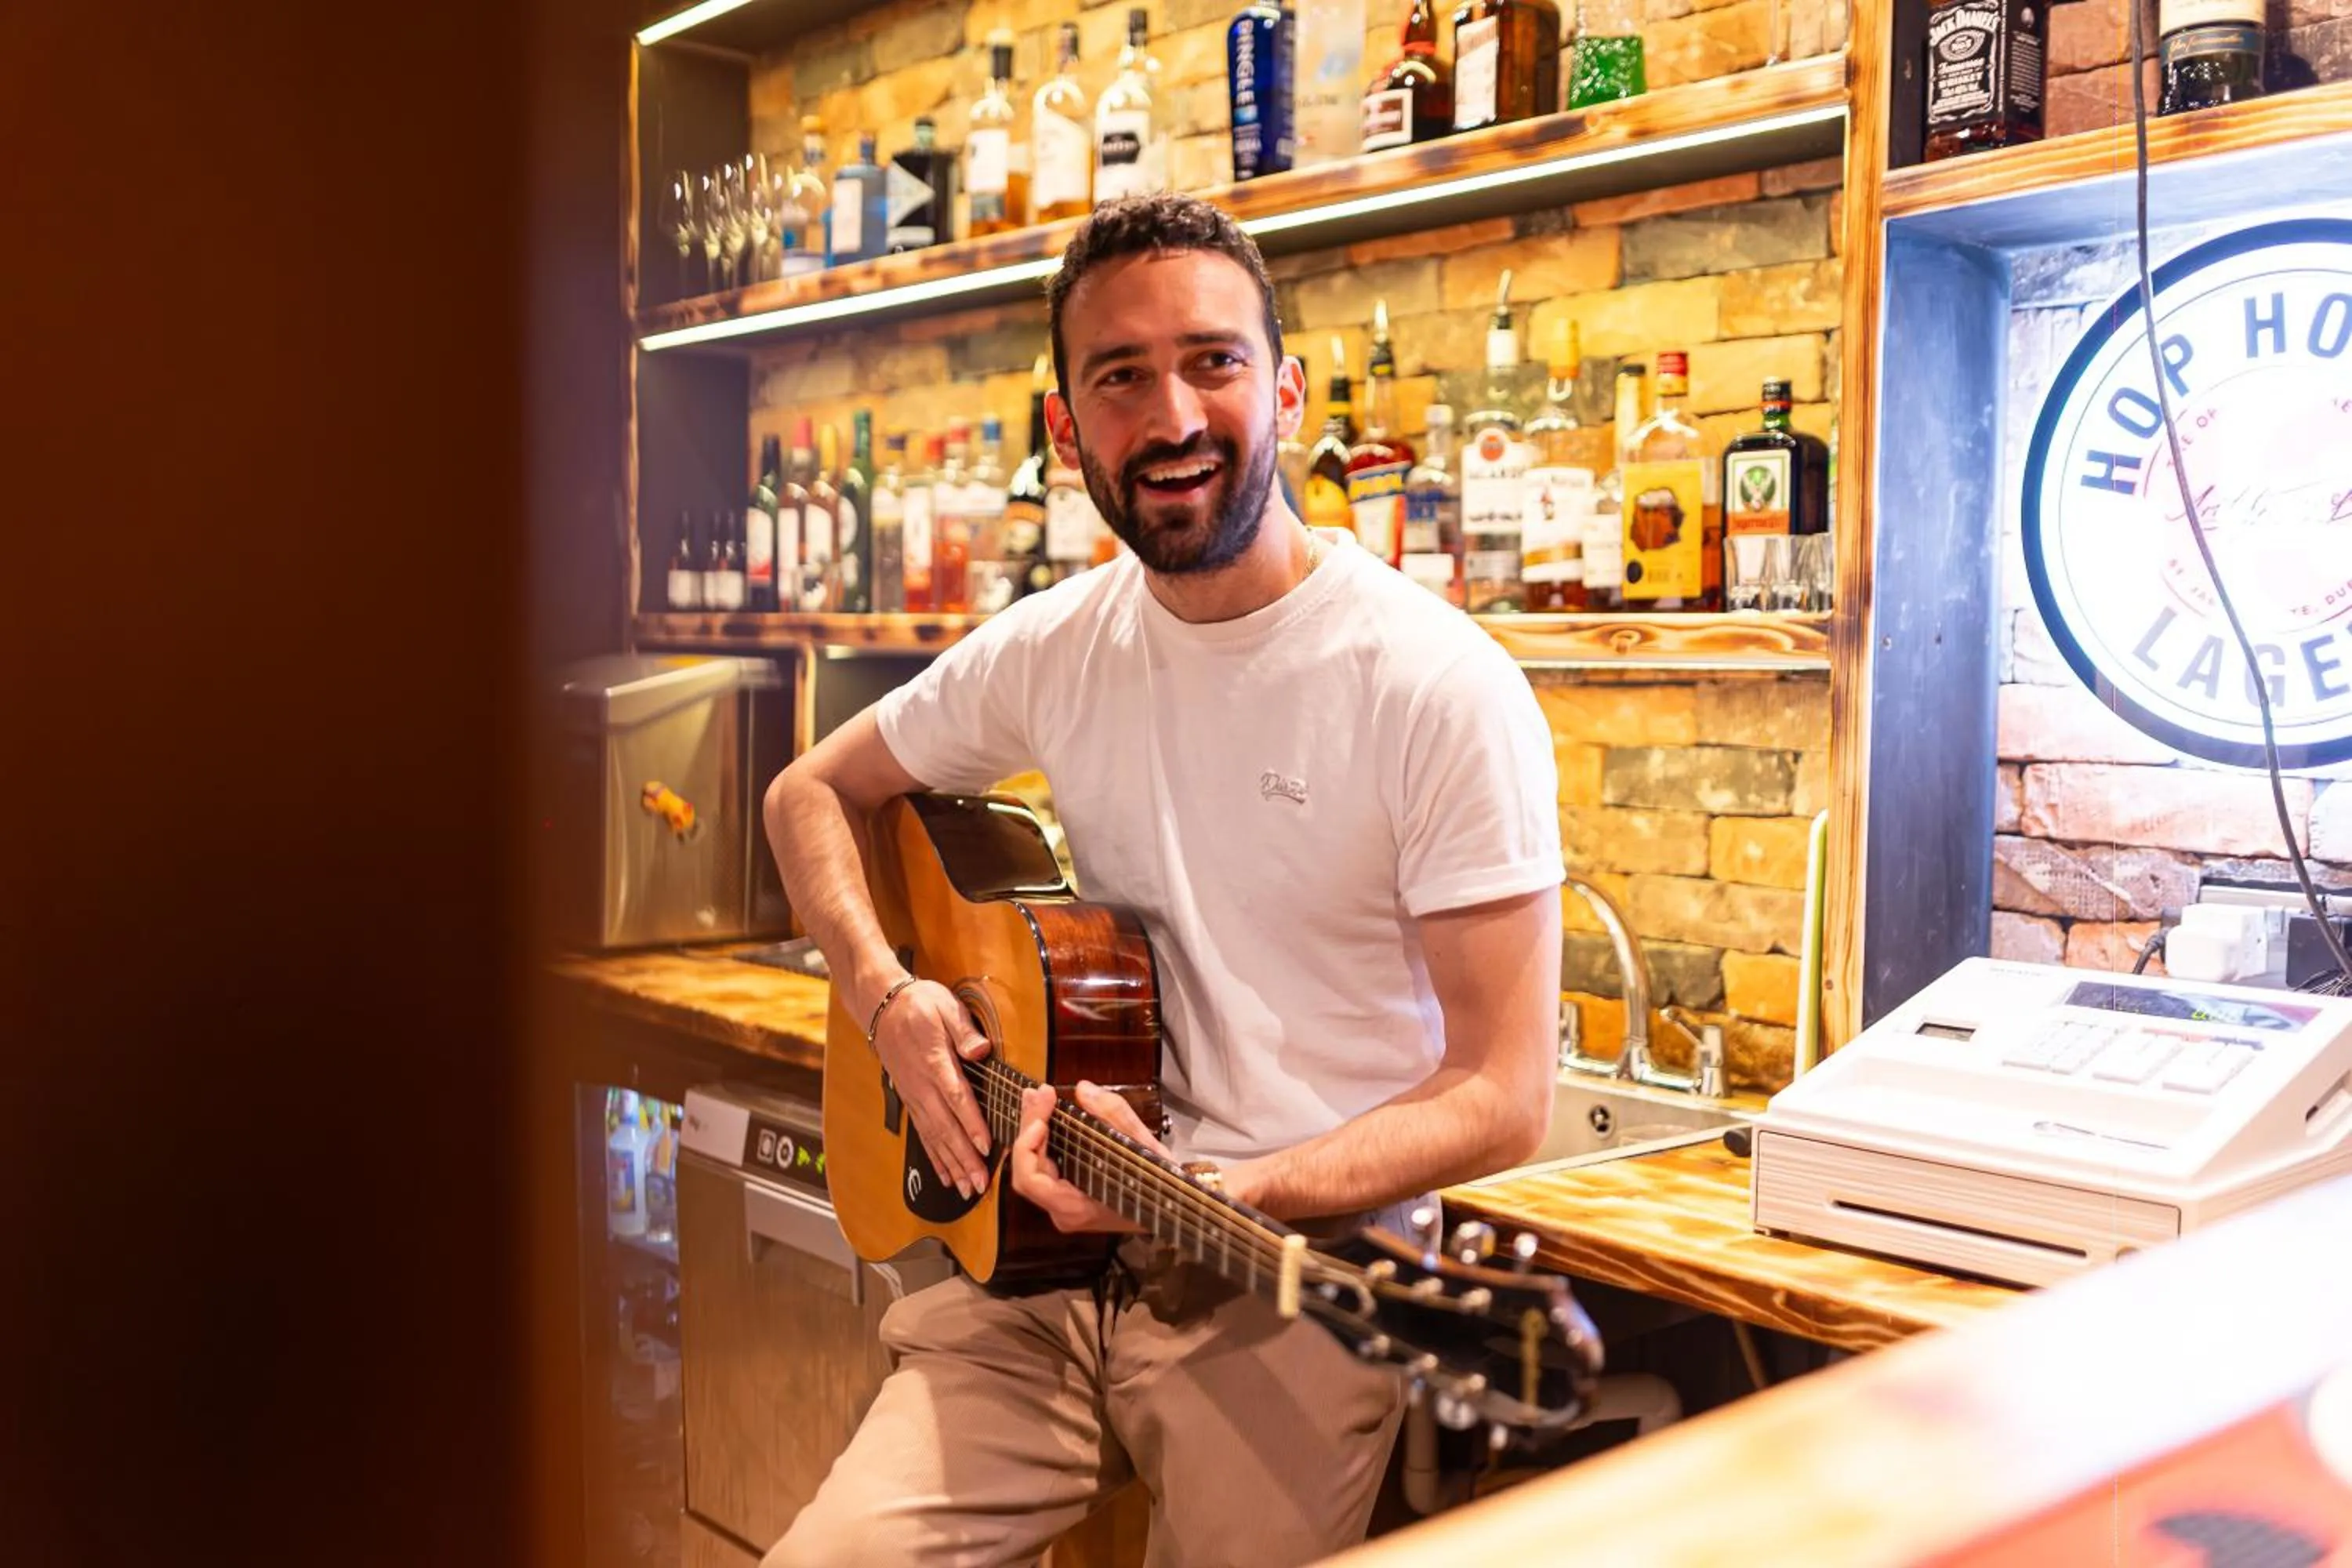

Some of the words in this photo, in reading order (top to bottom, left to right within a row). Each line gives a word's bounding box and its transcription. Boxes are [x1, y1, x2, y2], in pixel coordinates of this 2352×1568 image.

[1236, 20, 1255, 107] DINGLE
[2080, 333, 2194, 495] HOP
[2132, 605, 2352, 708] LAGE
